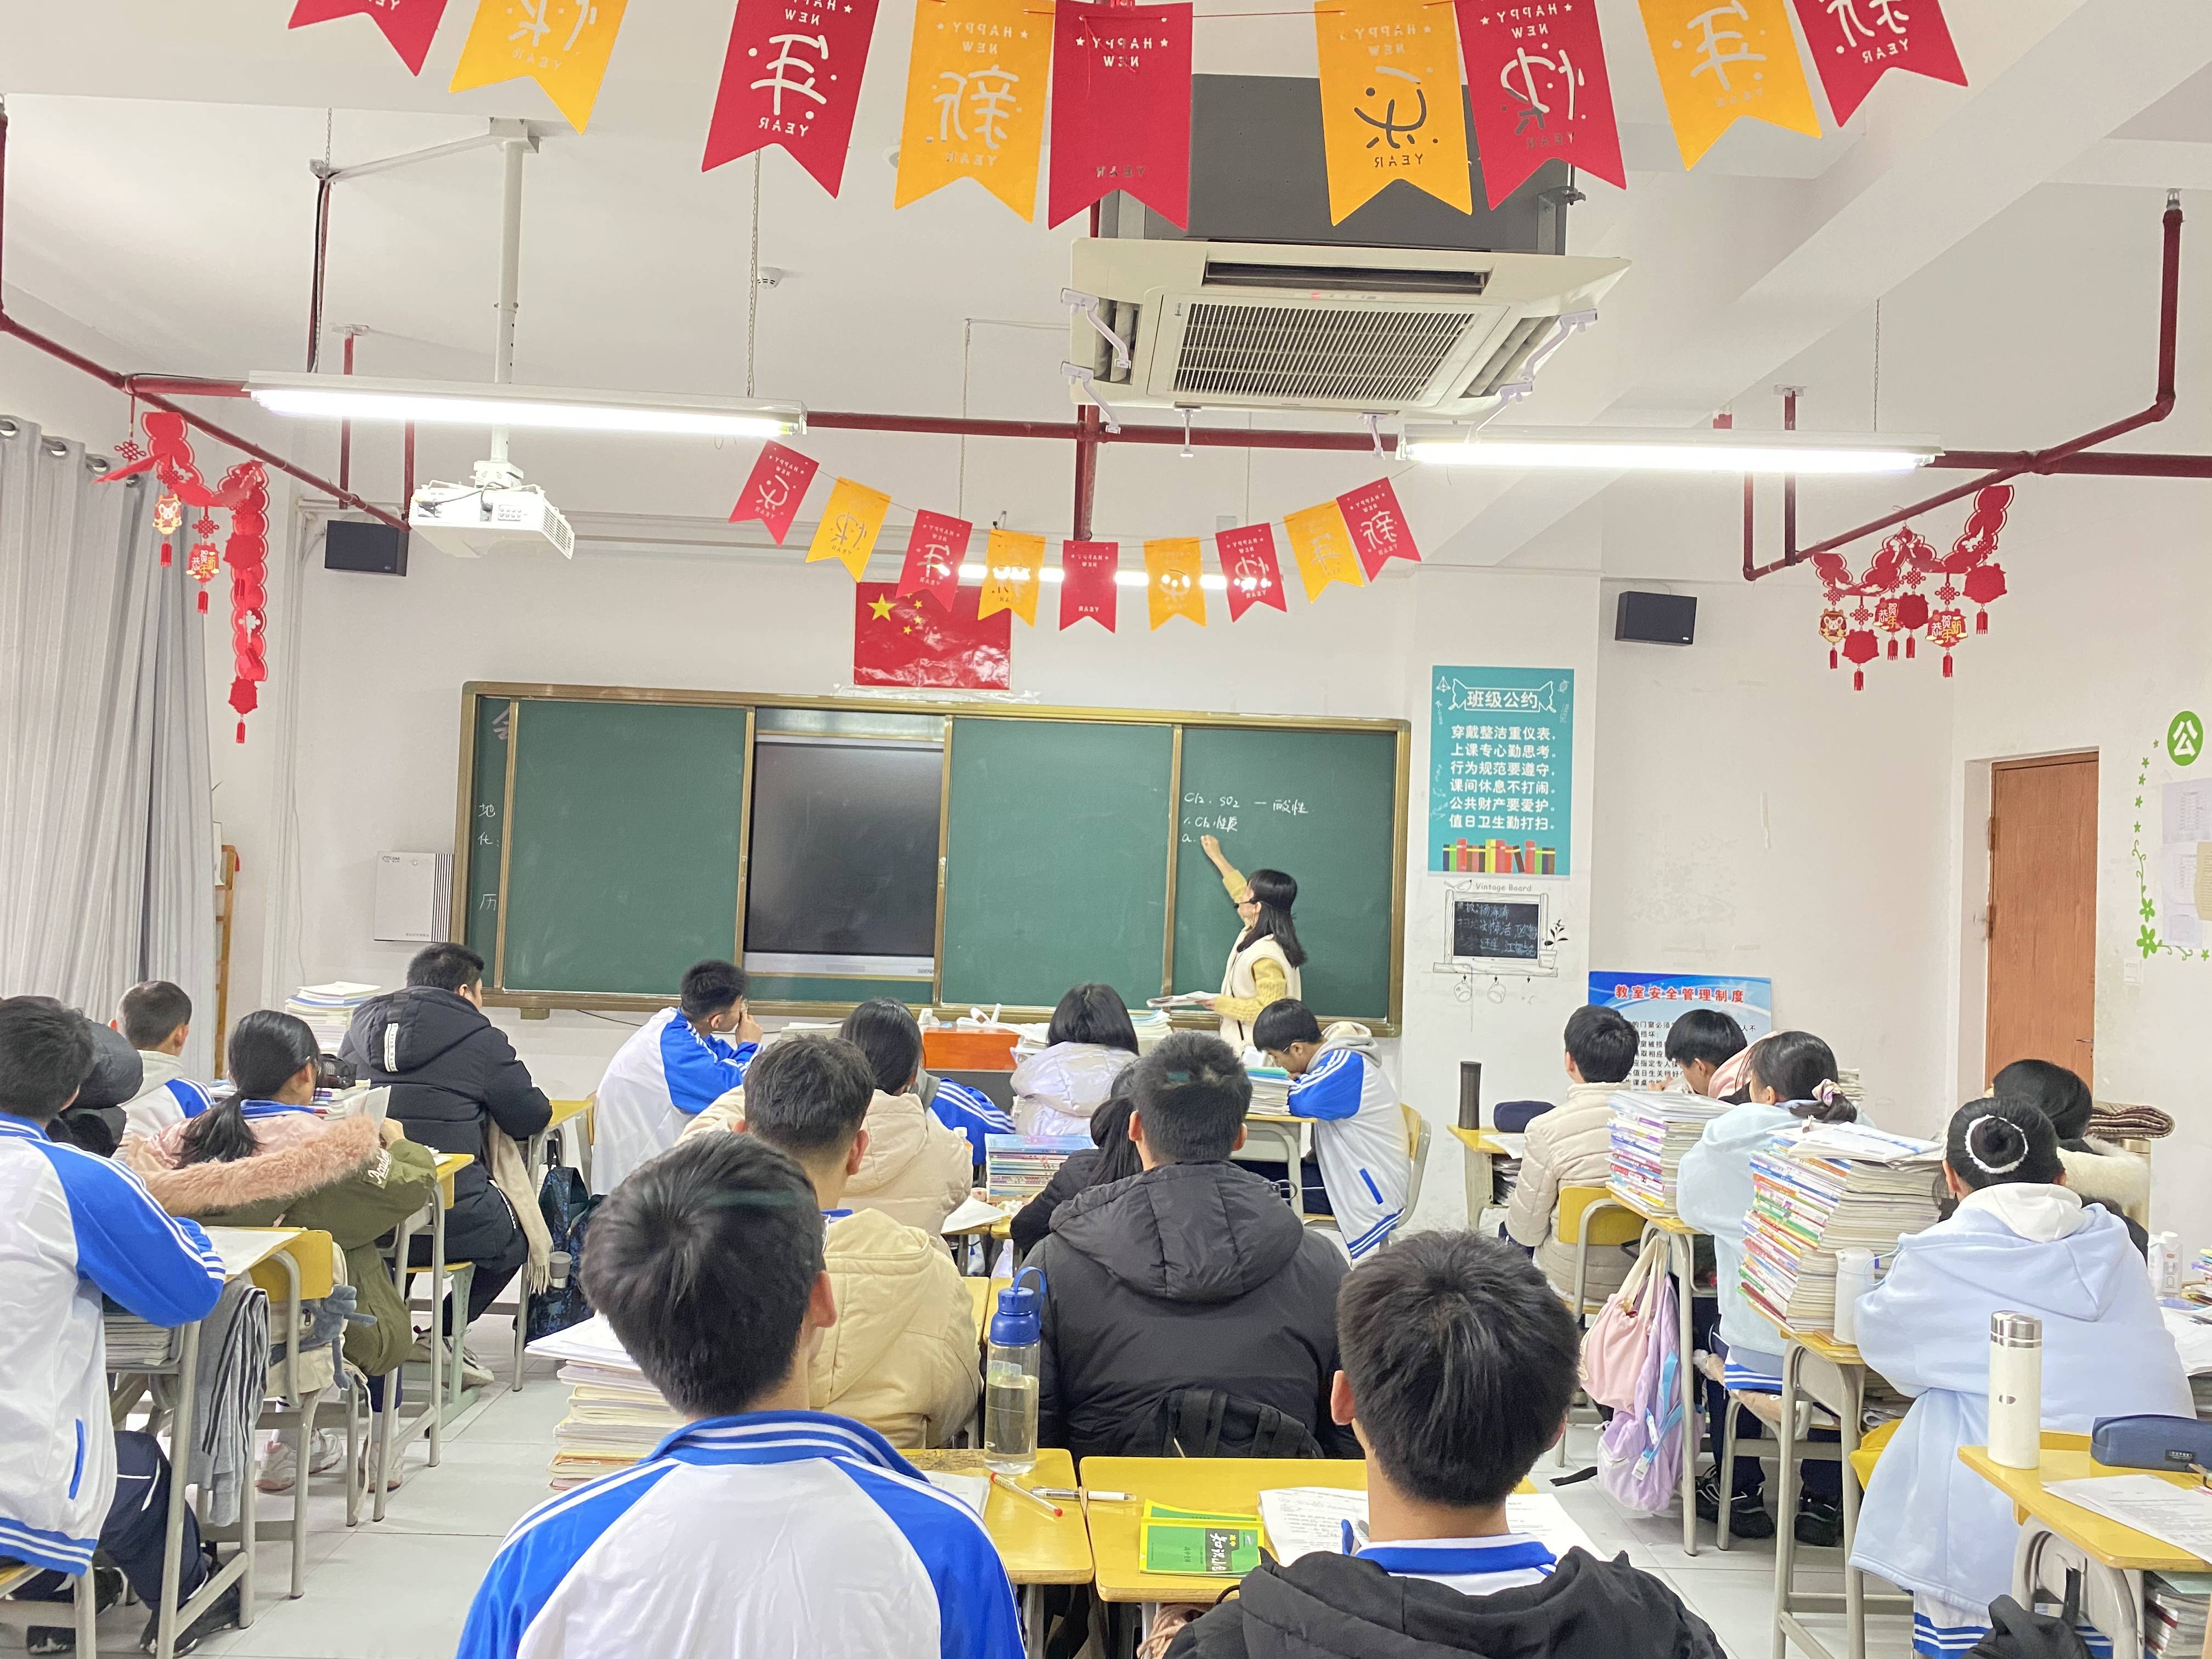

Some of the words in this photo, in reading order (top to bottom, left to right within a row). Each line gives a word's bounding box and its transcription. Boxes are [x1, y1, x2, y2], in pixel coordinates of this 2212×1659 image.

[1467, 690, 1538, 709] 班级公约
[1476, 883, 1506, 892] Vintage
[1615, 984, 1745, 1003] 教室安全管理制度
[1229, 1534, 1237, 1547] 高中
